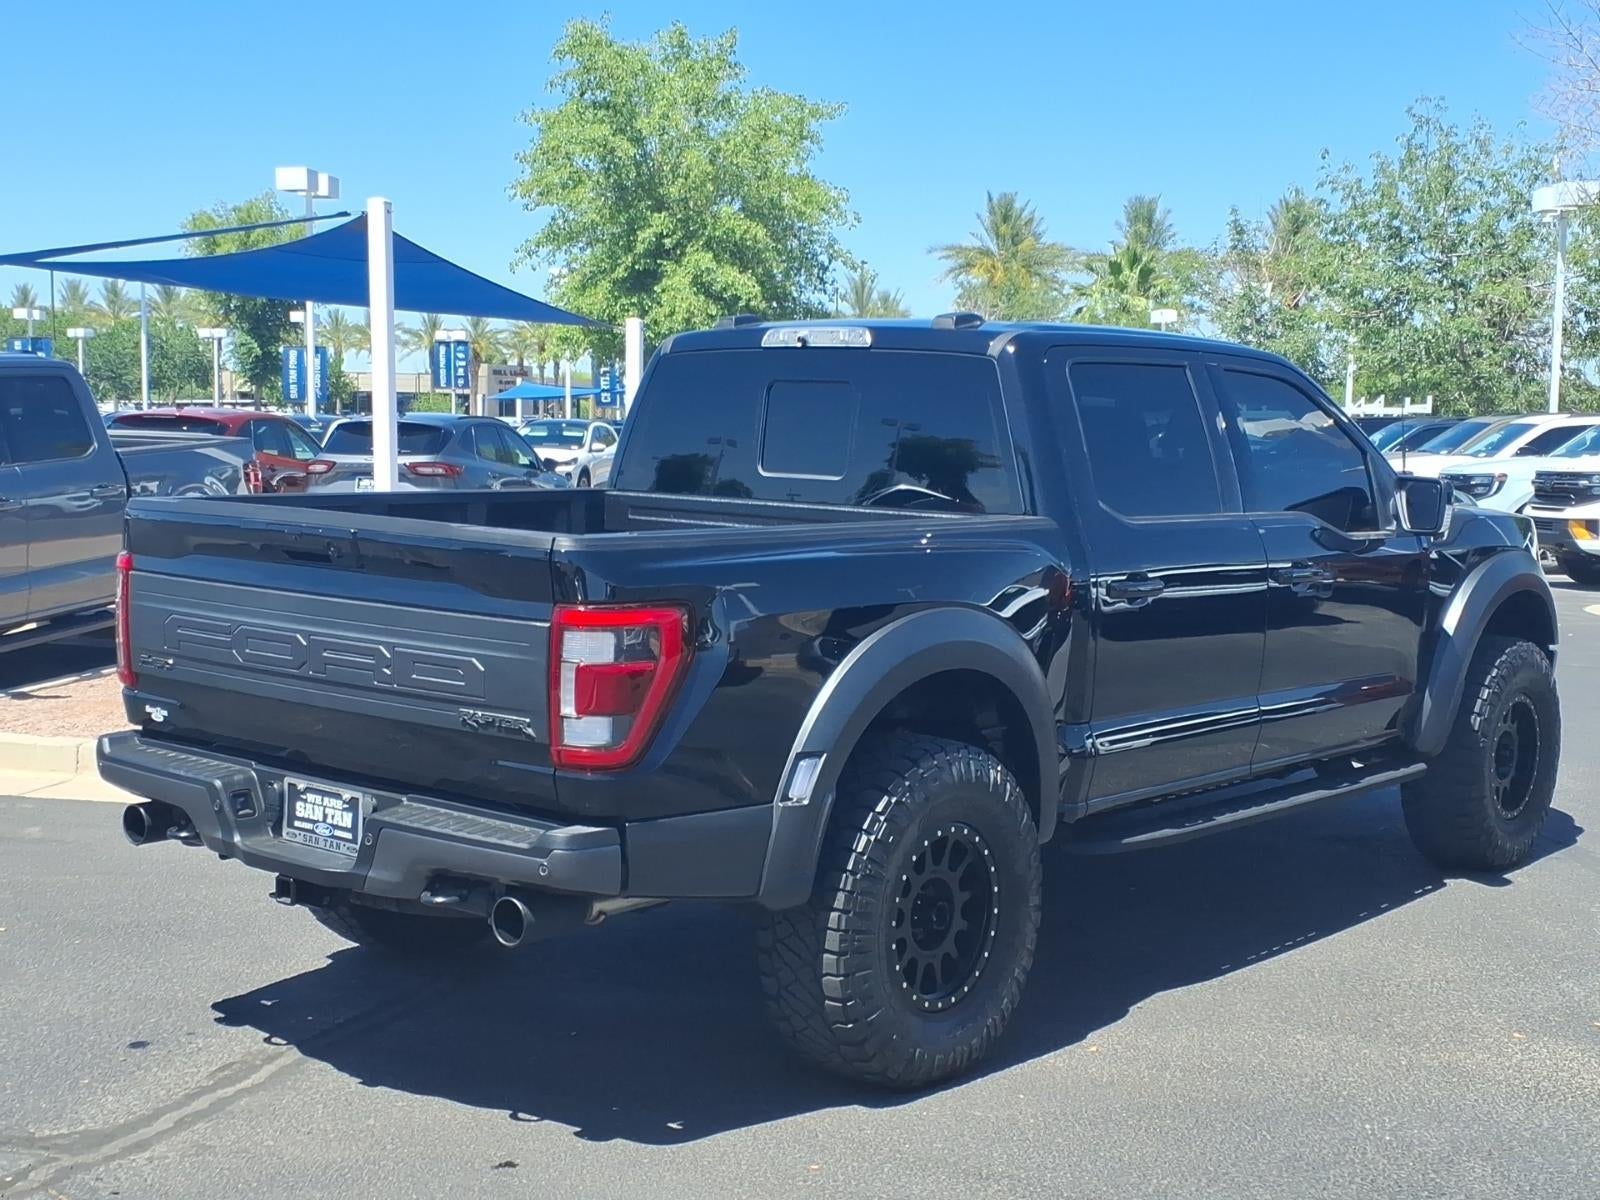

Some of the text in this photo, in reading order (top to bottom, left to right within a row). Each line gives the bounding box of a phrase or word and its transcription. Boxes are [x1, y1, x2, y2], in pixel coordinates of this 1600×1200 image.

[289, 350, 298, 399] SAN TAN FORD
[164, 615, 486, 701] FORD
[459, 708, 537, 738] RAPTOR
[295, 801, 324, 822] SAN
[325, 807, 353, 829] TAN
[306, 793, 343, 810] WE ARE
[302, 833, 320, 846] SAN
[321, 839, 341, 851] TAN
